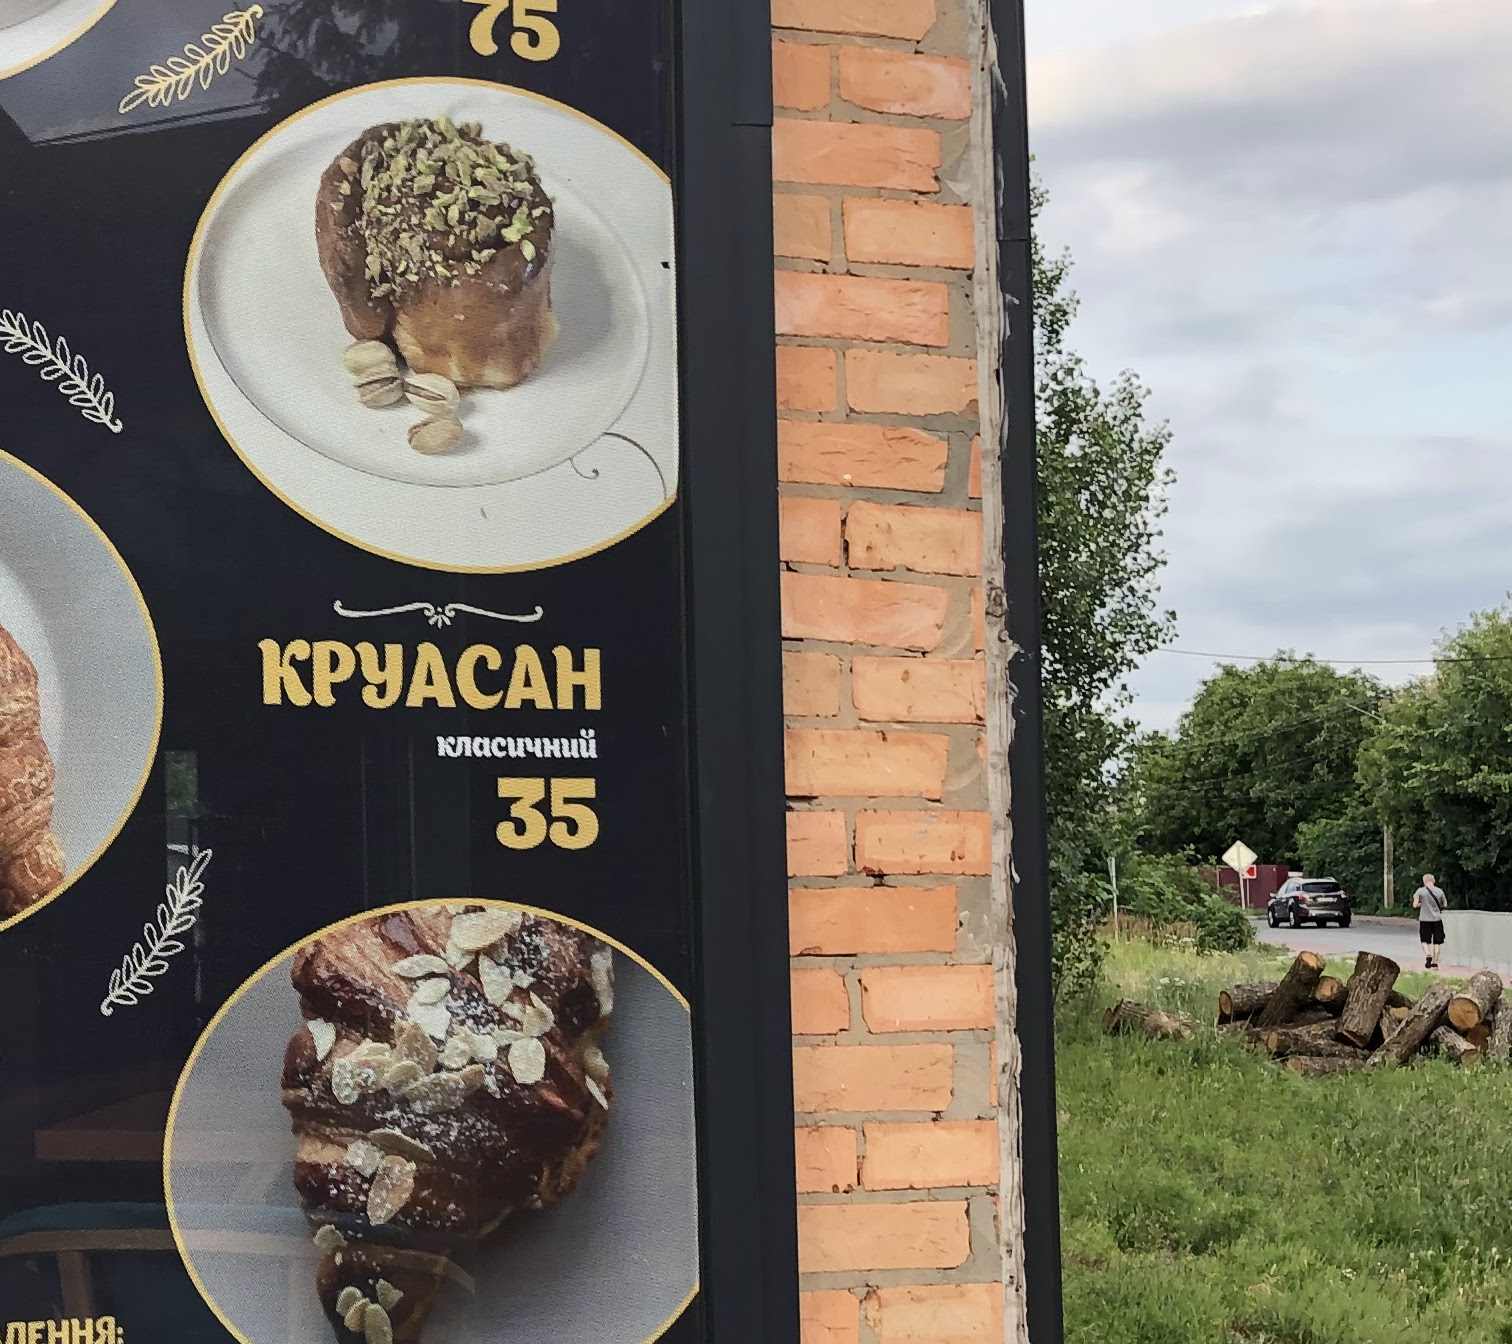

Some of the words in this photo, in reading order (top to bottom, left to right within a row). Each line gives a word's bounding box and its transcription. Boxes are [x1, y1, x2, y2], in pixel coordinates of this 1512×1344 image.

[257, 638, 602, 711] КРУАСАН
[436, 728, 598, 759] класичний
[495, 777, 599, 851] 35
